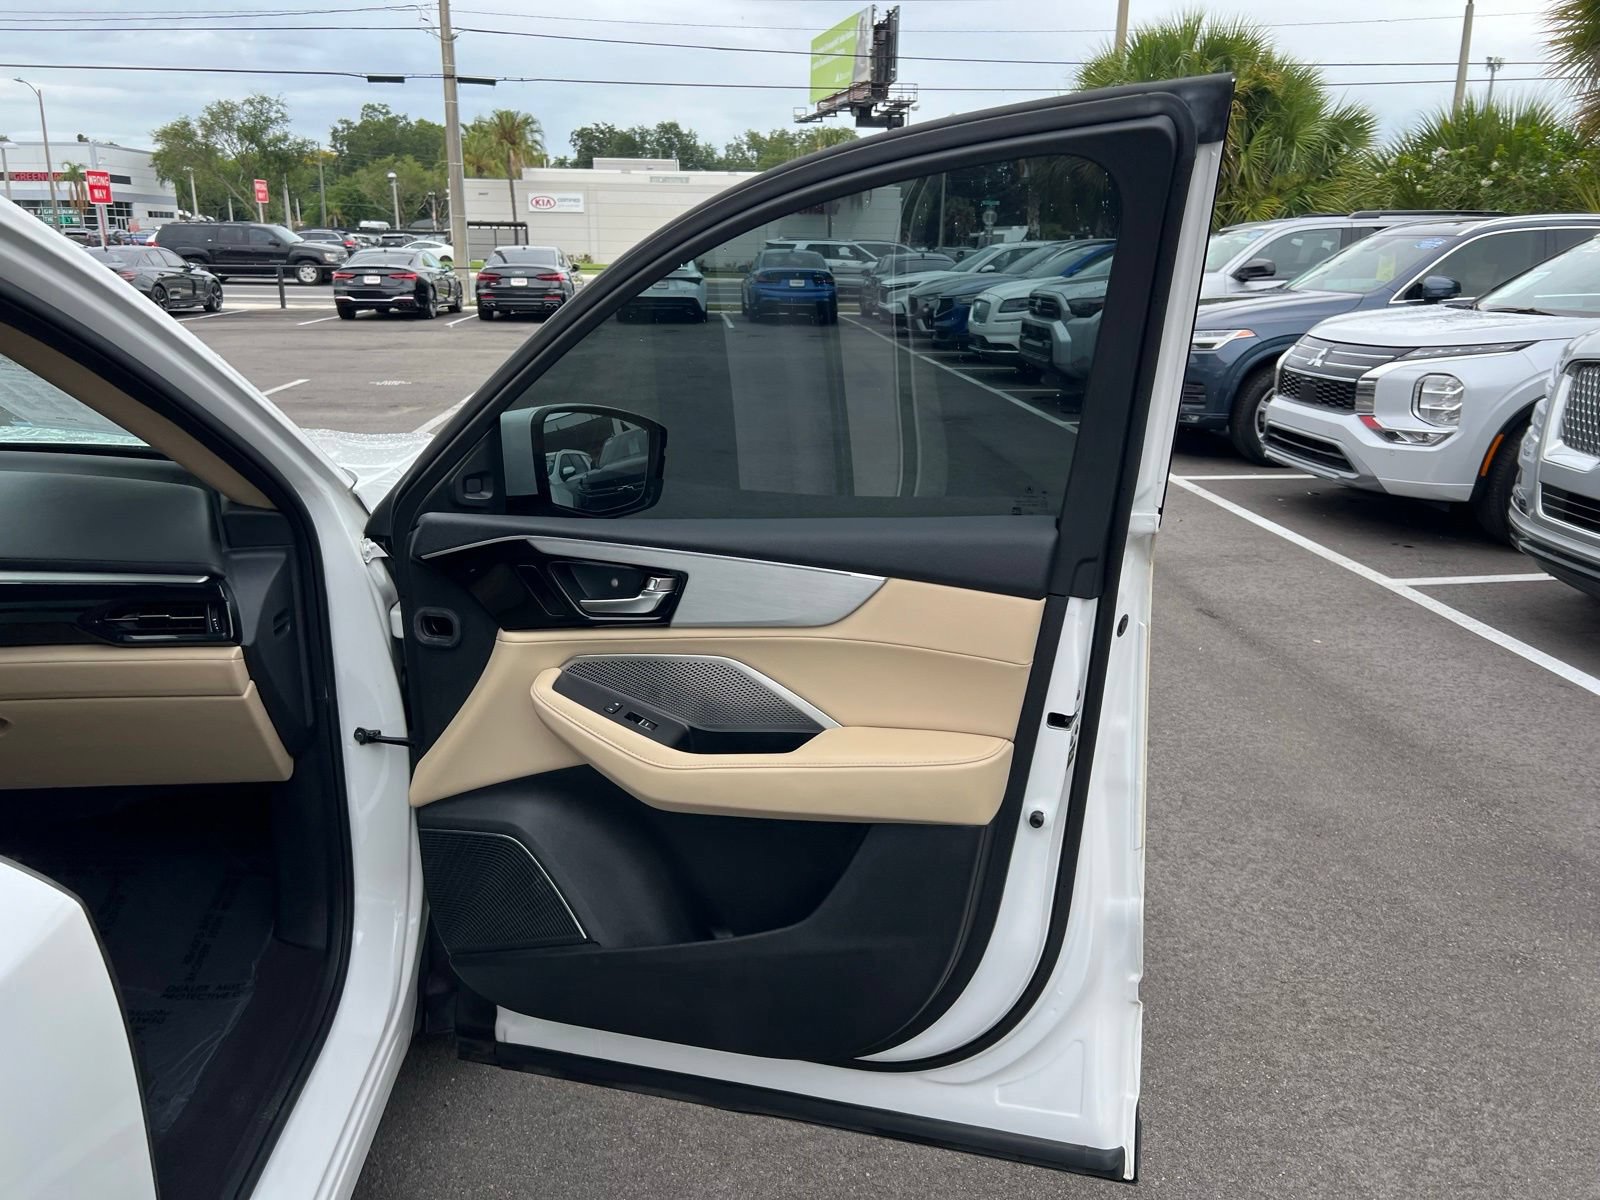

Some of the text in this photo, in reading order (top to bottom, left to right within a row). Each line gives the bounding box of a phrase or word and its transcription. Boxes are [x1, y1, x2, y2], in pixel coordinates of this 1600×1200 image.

[89, 176, 109, 187] WRONG
[94, 189, 107, 199] WAY
[535, 199, 552, 207] KIA
